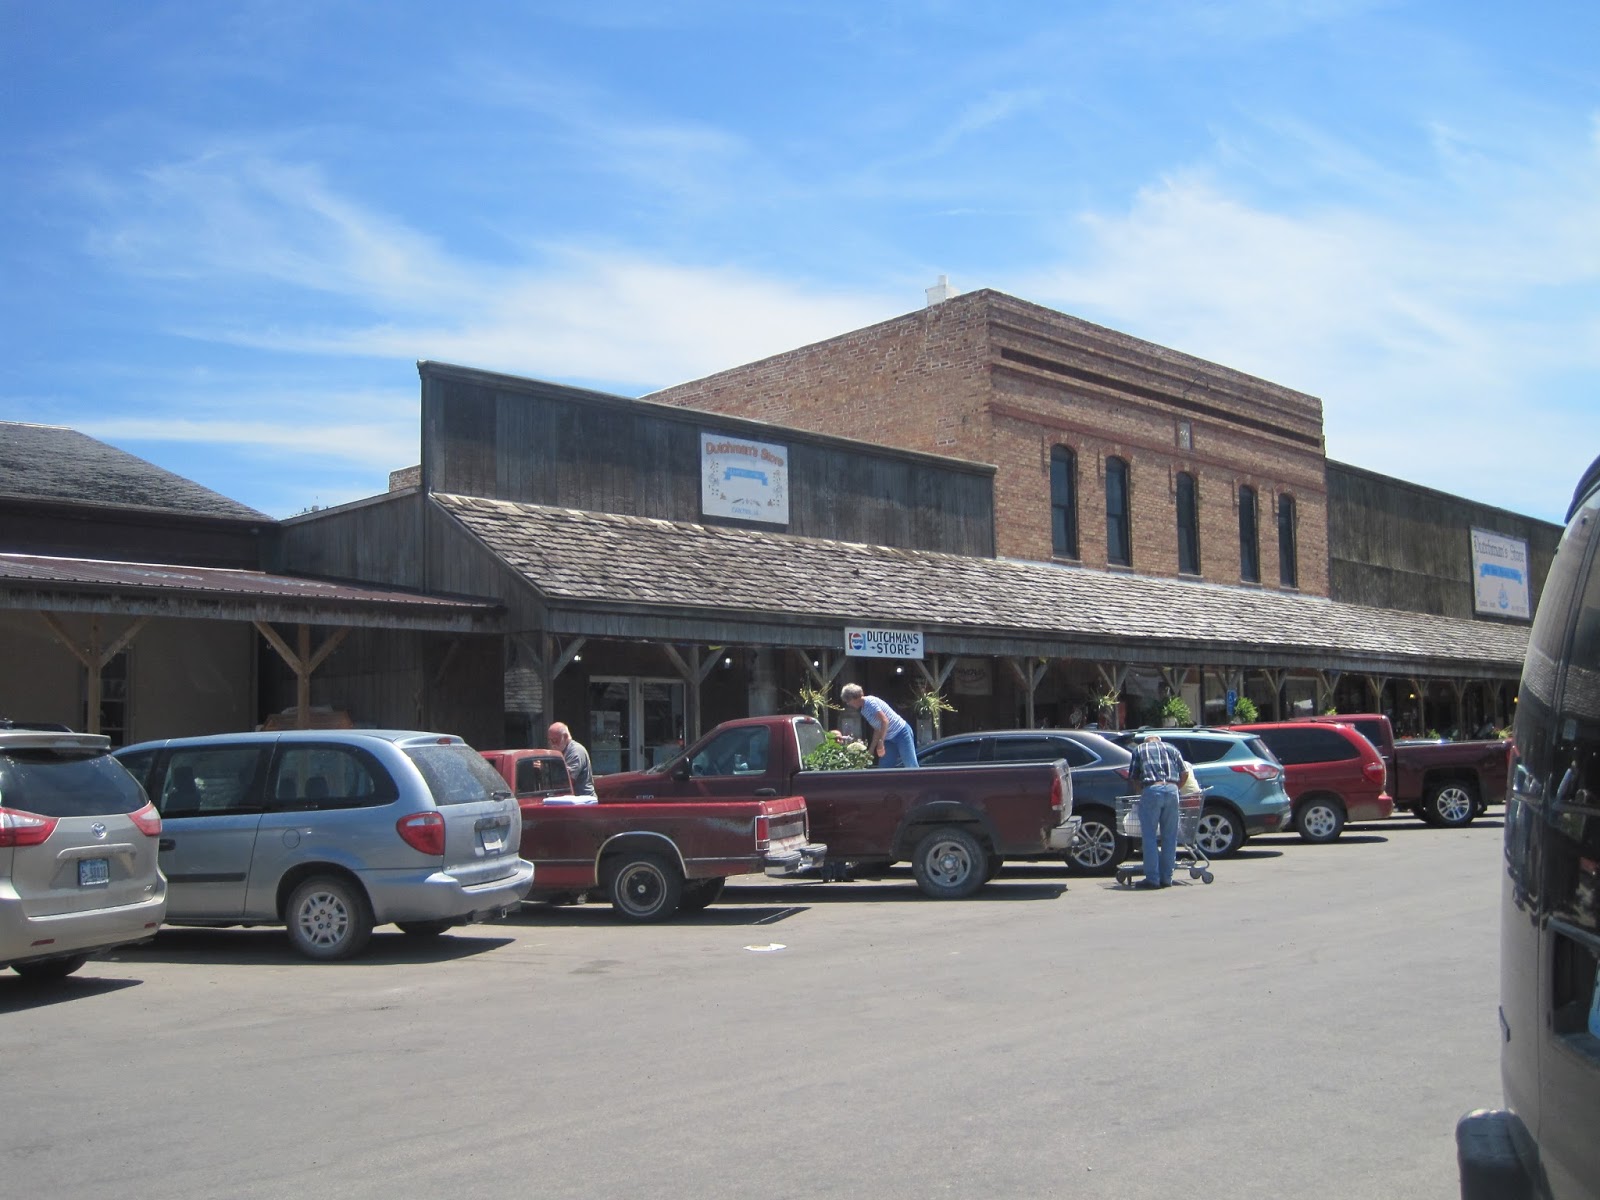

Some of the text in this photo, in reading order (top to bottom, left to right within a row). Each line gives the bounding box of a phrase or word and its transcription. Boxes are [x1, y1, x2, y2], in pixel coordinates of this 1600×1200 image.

[761, 448, 784, 467] Store
[867, 630, 919, 644] DUTCHMANS
[876, 642, 910, 655] STORE
